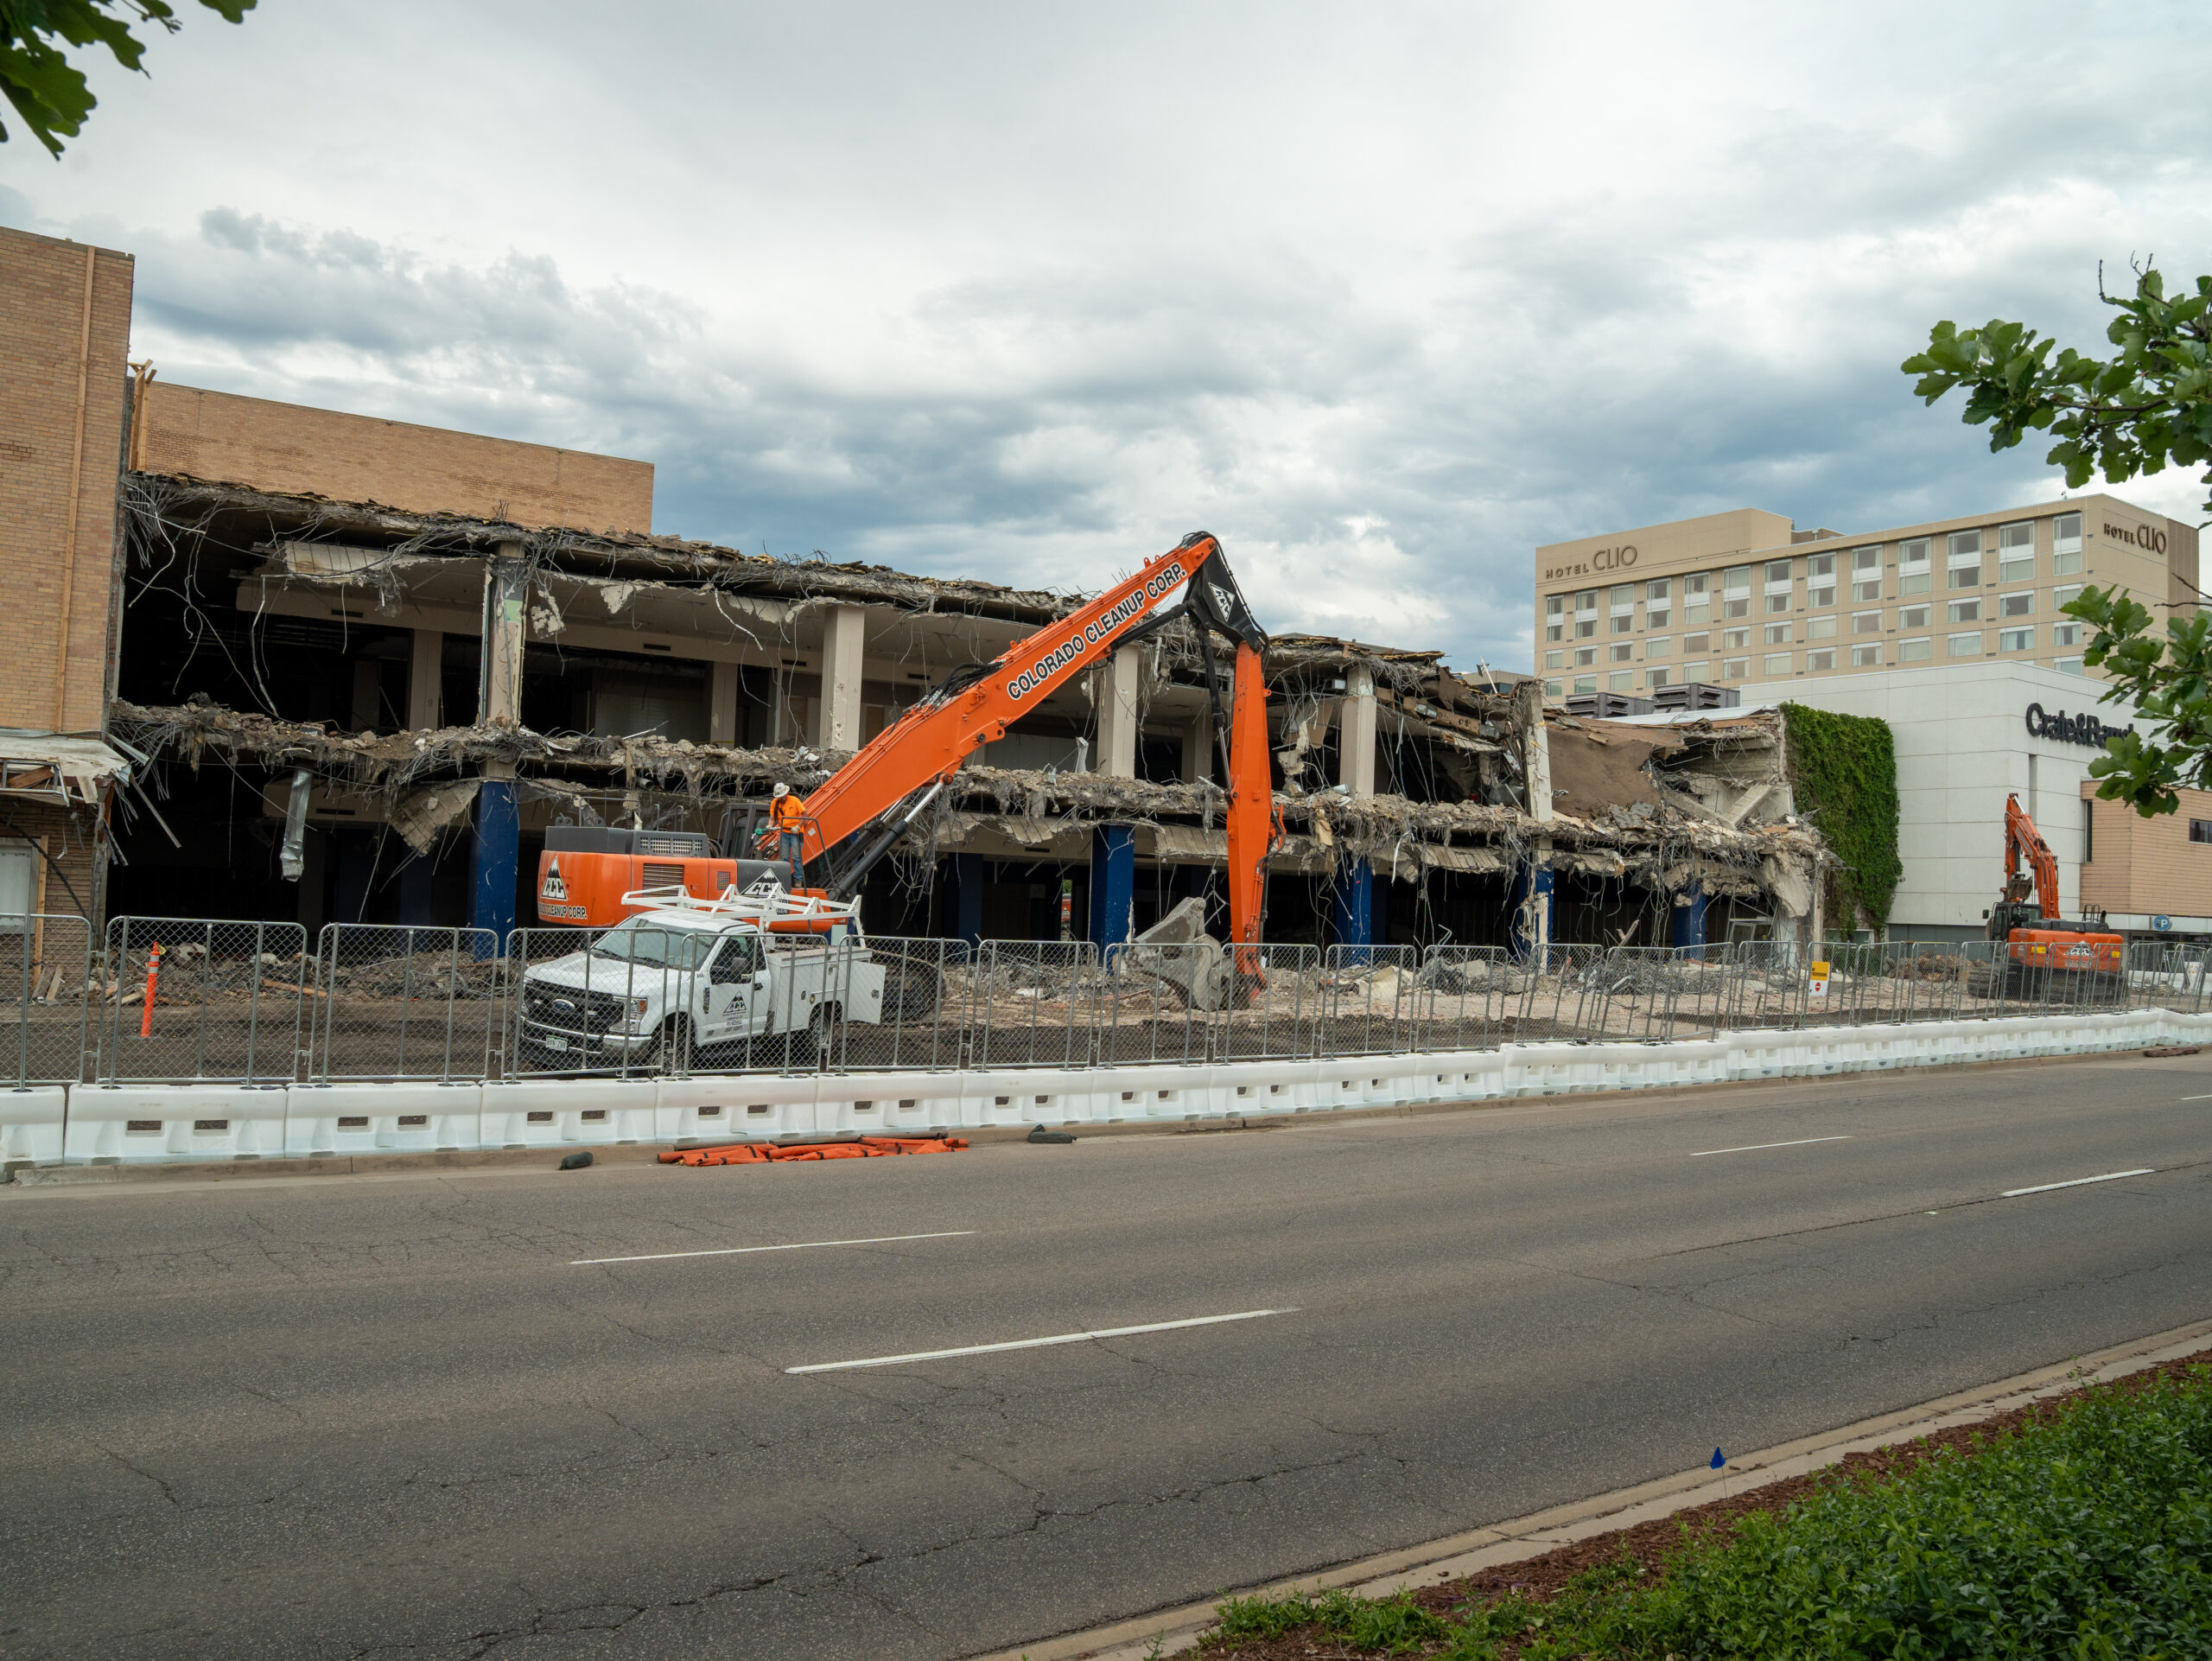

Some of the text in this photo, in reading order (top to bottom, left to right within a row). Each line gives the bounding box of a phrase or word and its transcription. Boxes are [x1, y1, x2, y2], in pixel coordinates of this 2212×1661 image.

[2104, 523, 2166, 554] HOTEL CLIO
[1546, 545, 1637, 579] HOTEL CLIO
[1007, 562, 1186, 700] COLORADO CLEANUP CORP.
[542, 877, 565, 899] CCC
[547, 904, 567, 917] CLEANUP
[568, 906, 588, 920] CORP.
